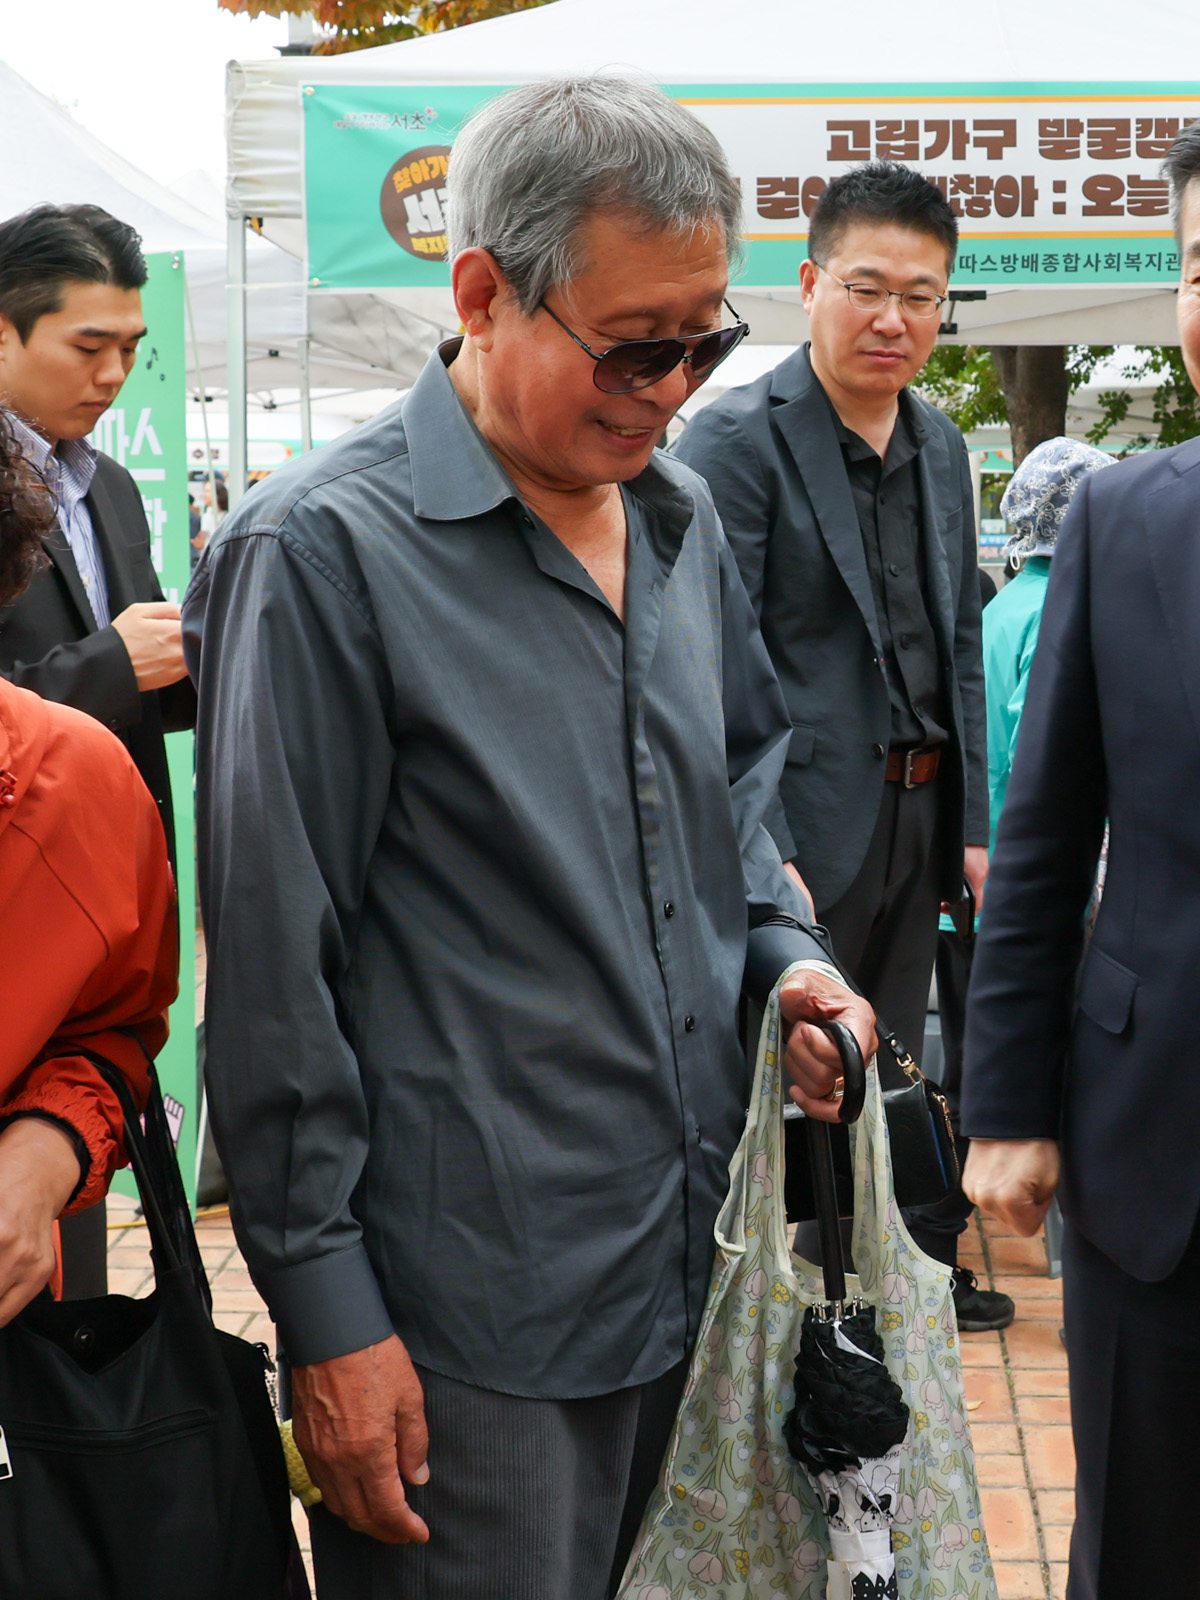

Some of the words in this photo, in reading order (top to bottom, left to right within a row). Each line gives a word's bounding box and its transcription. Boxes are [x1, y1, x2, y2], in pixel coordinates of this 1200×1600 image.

[390, 111, 427, 131] 서초
[827, 119, 1017, 161] 고립가구
[1040, 118, 1199, 160] 발굴캠
[392, 154, 450, 193] 찾아가
